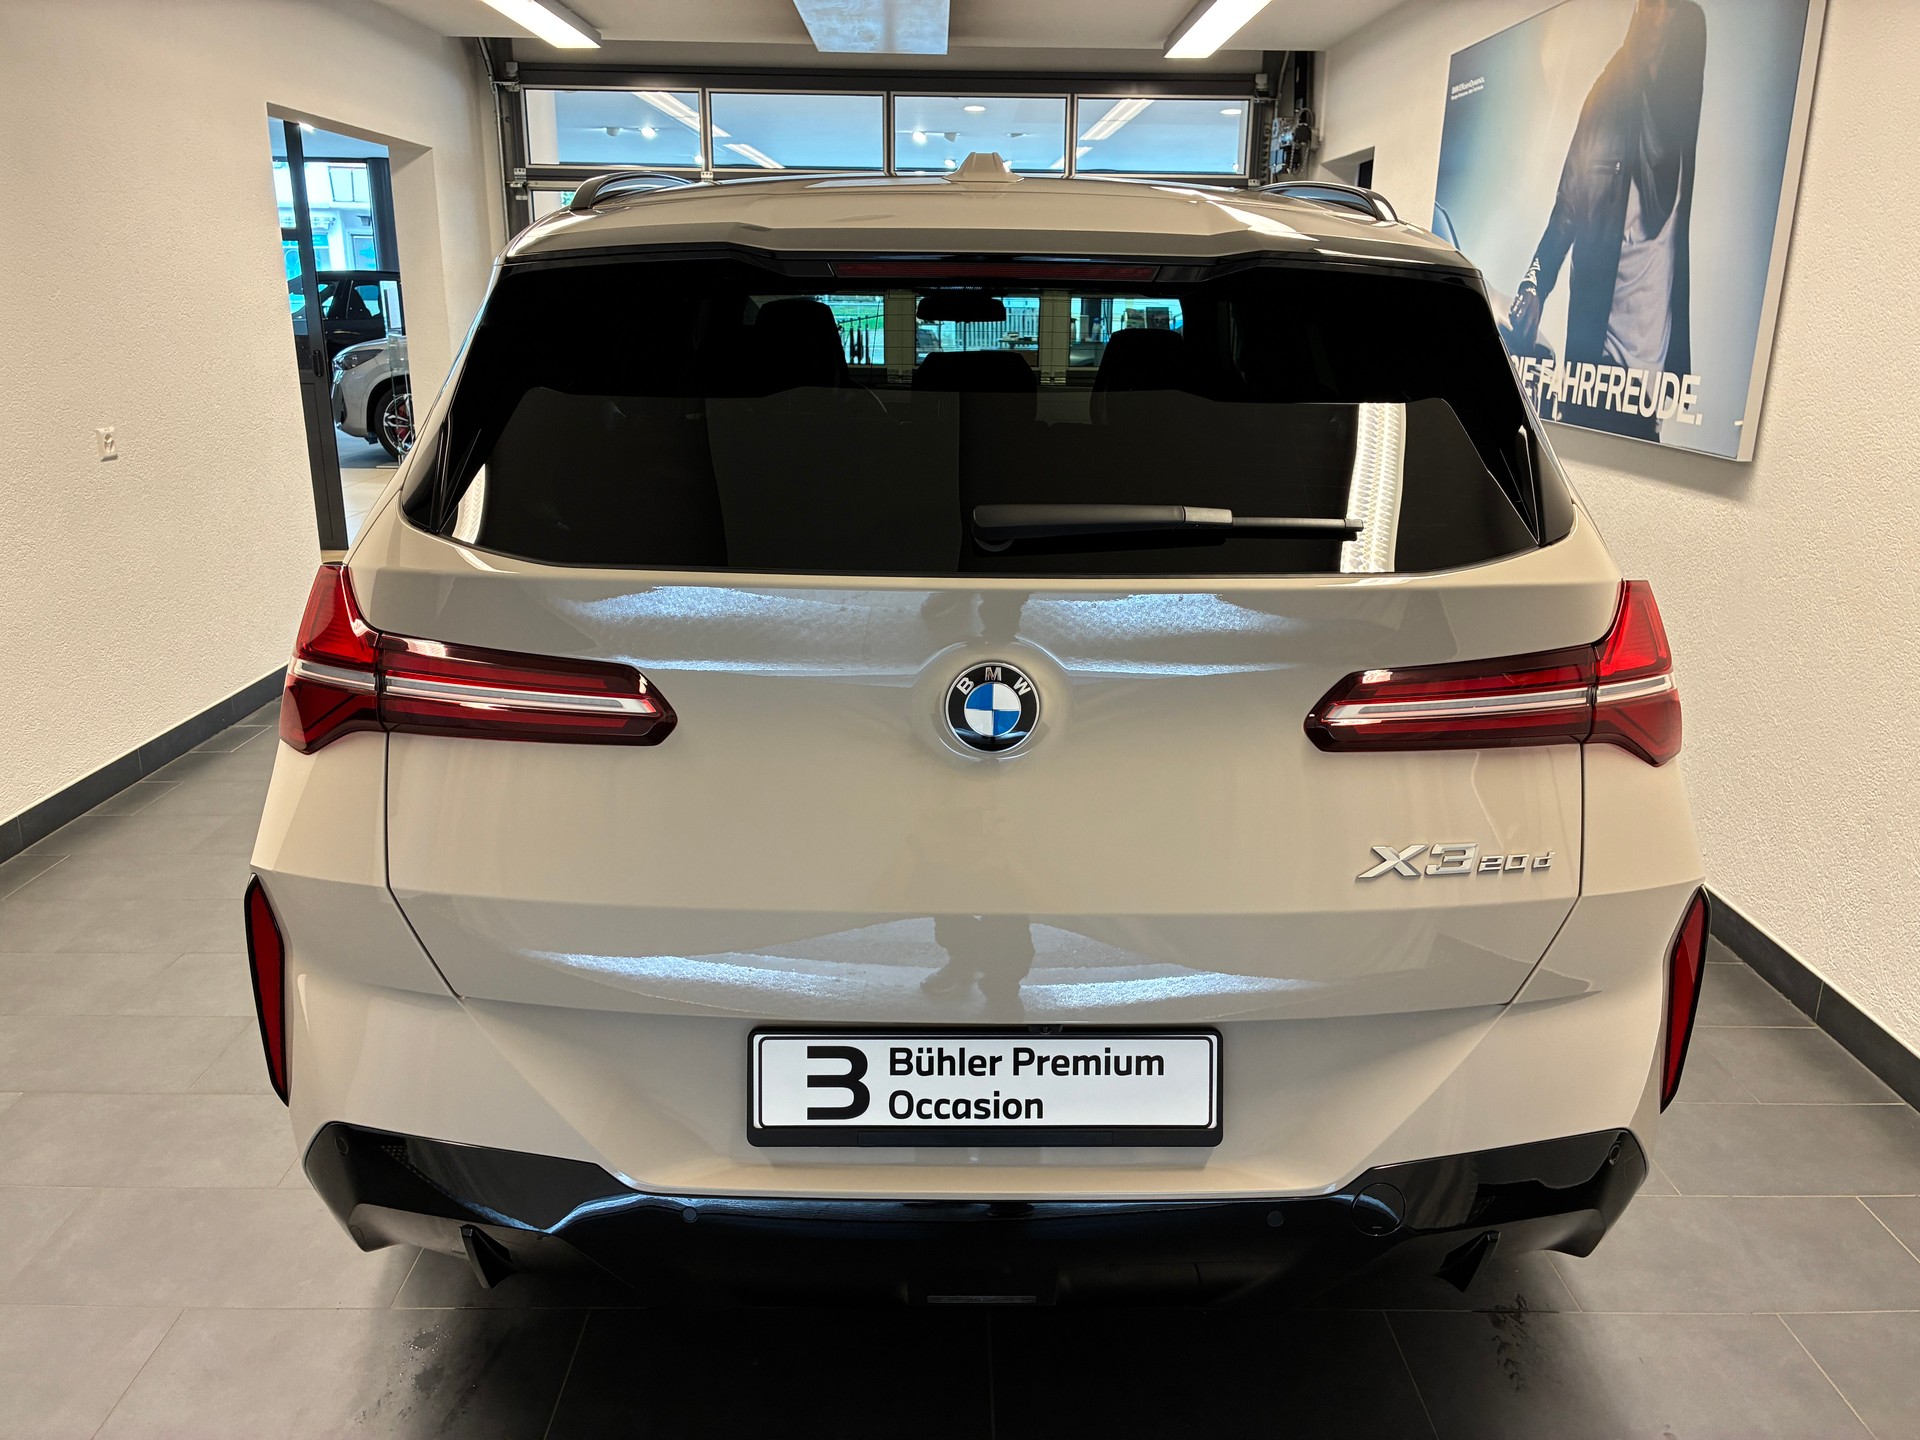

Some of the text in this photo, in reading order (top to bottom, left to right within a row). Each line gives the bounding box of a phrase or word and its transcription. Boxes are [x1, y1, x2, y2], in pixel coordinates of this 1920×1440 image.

[1510, 354, 1703, 426] IE FAHRFREUDE.
[956, 666, 1032, 696] BMW
[888, 1046, 1166, 1077] Bühler Premium
[888, 1089, 1044, 1120] Occasion
